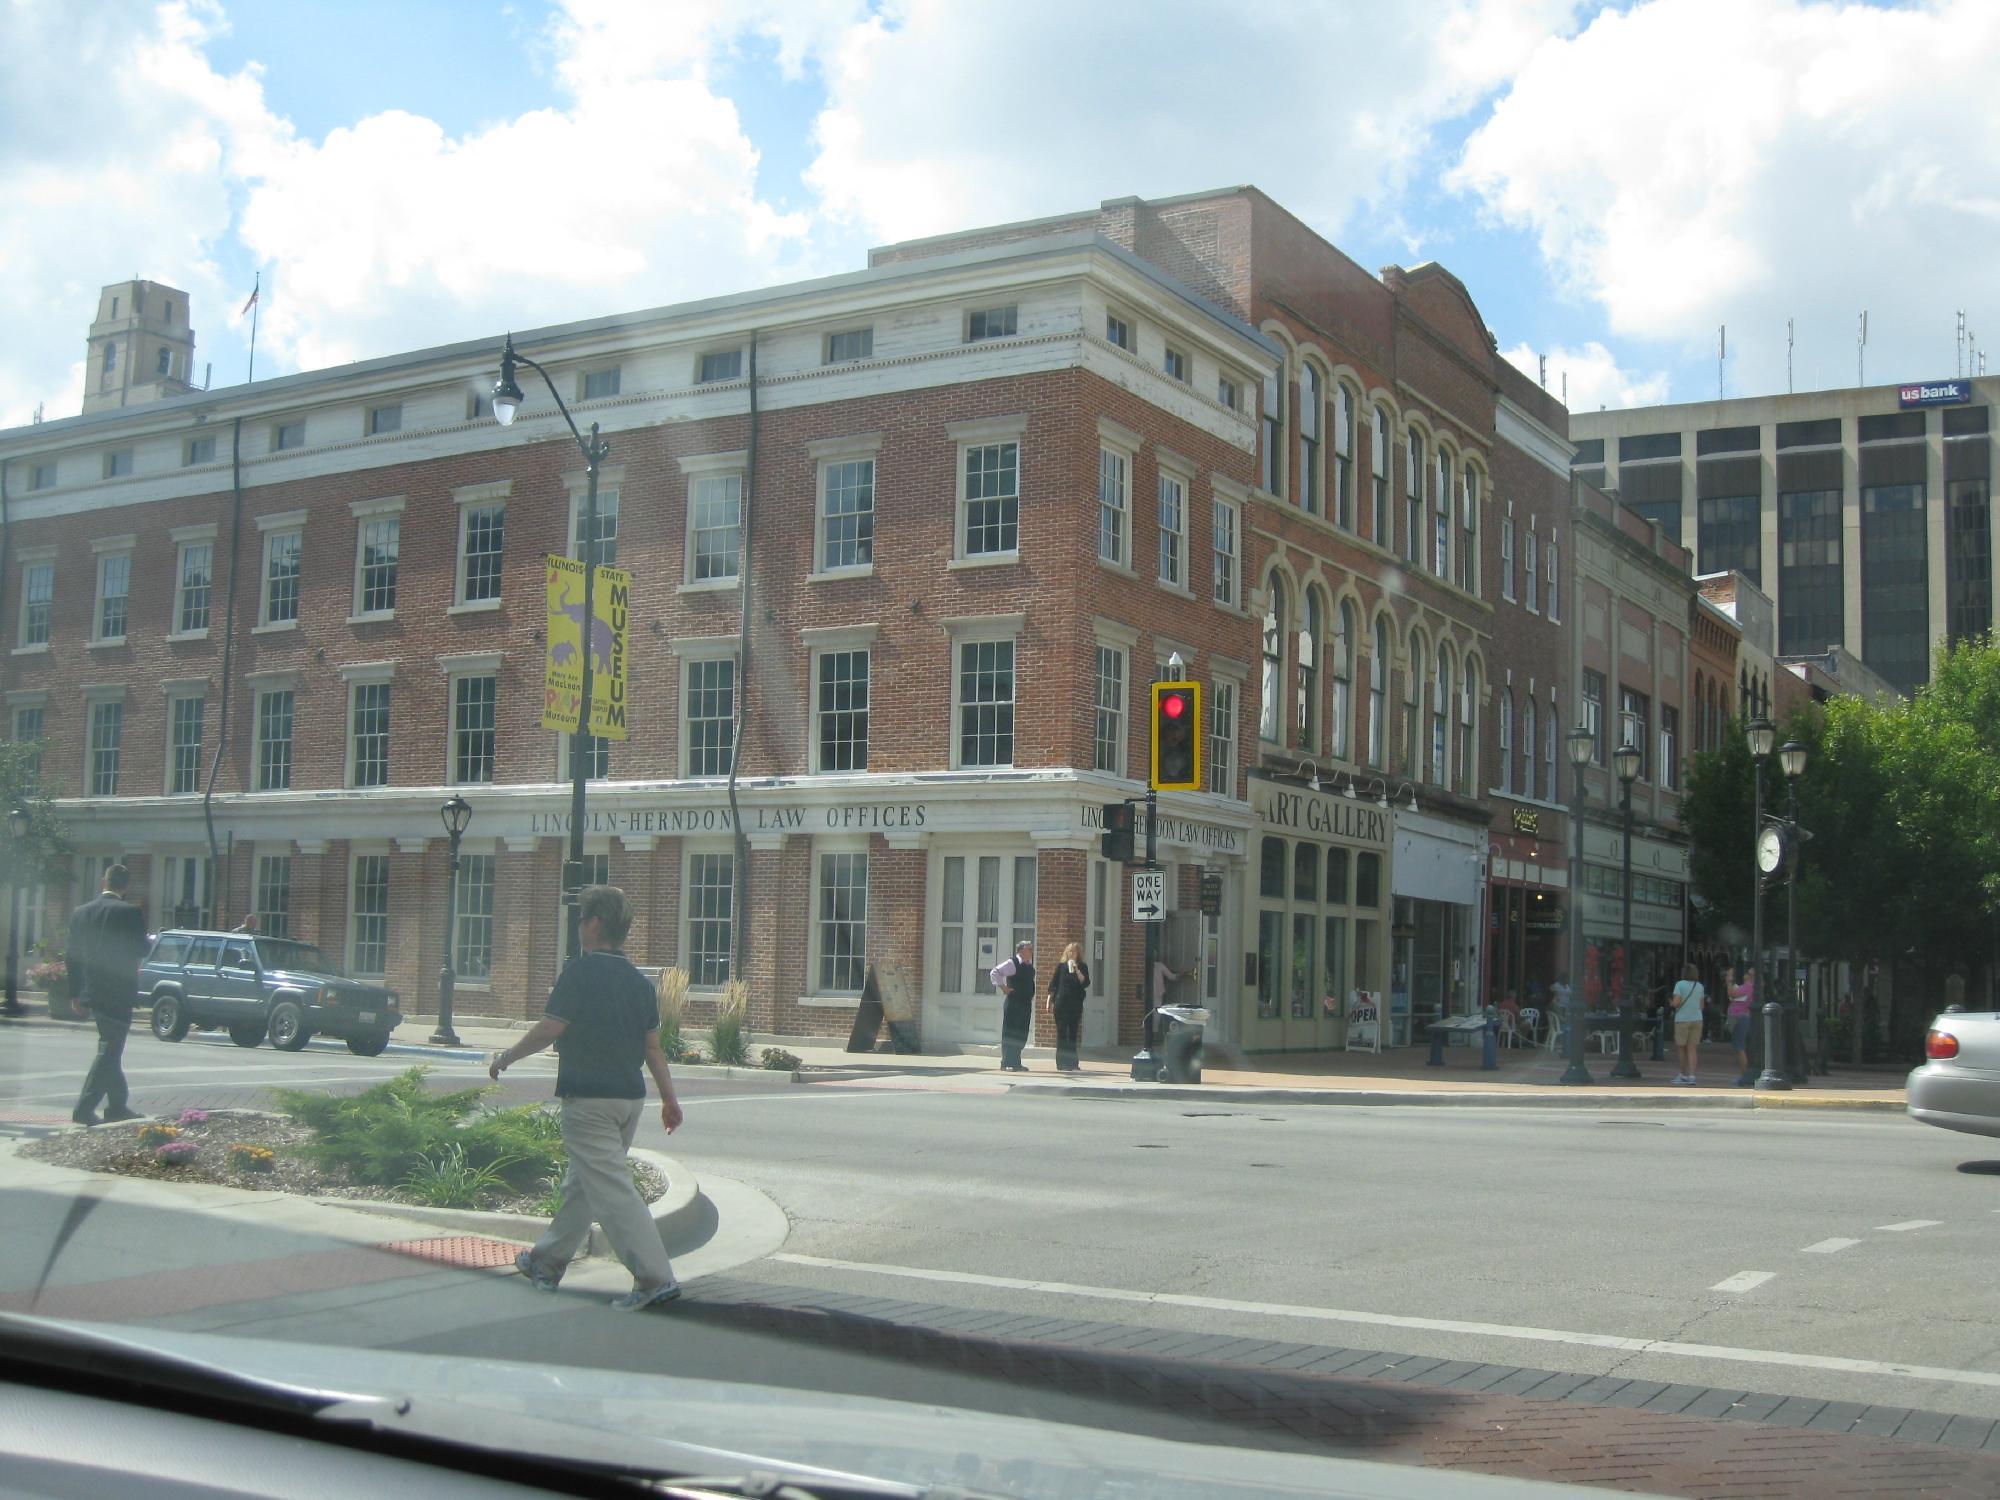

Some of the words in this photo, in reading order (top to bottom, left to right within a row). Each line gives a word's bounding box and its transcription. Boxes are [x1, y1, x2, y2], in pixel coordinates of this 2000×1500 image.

[547, 558, 584, 574] ILLINOIS
[600, 570, 624, 581] STATE
[606, 584, 628, 728] MUSEUM
[545, 710, 578, 723] Museum
[758, 808, 806, 829] LAW
[826, 805, 926, 828] OFFICES
[1263, 792, 1302, 827] ART
[1307, 798, 1389, 842] GALLERY
[1179, 822, 1203, 846] LAW
[1202, 825, 1236, 850] OFFICES
[1136, 876, 1161, 889] ONE
[1136, 889, 1161, 902] WAY
[1350, 1007, 1378, 1024] OPEN
